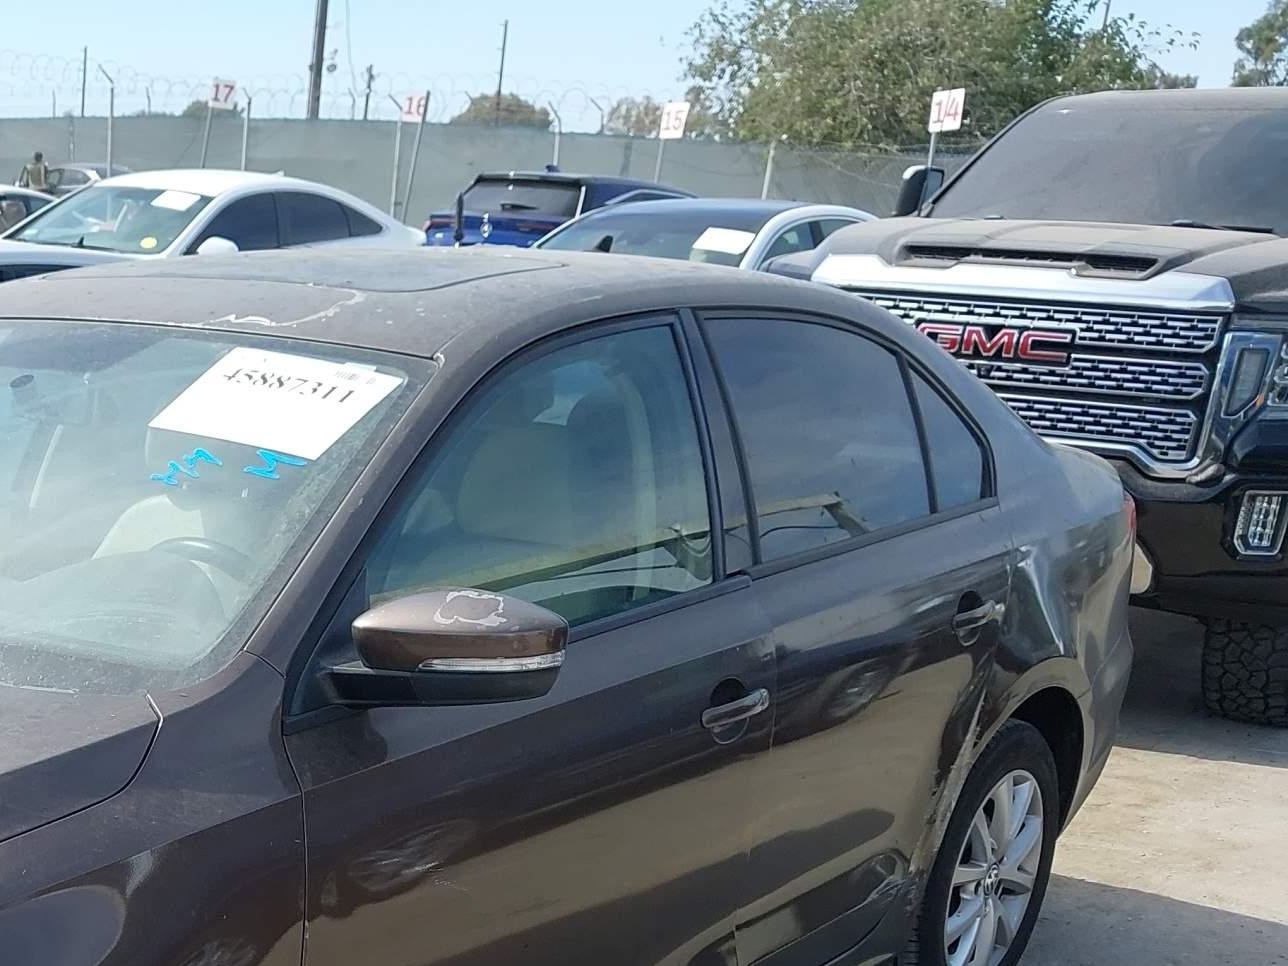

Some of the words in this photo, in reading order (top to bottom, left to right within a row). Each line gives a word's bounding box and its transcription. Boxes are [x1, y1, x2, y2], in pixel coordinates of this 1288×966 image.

[212, 84, 235, 103] 17
[662, 109, 684, 131] 15
[932, 97, 959, 124] 14
[917, 322, 1073, 363] GMC
[223, 368, 355, 403] 45887311
